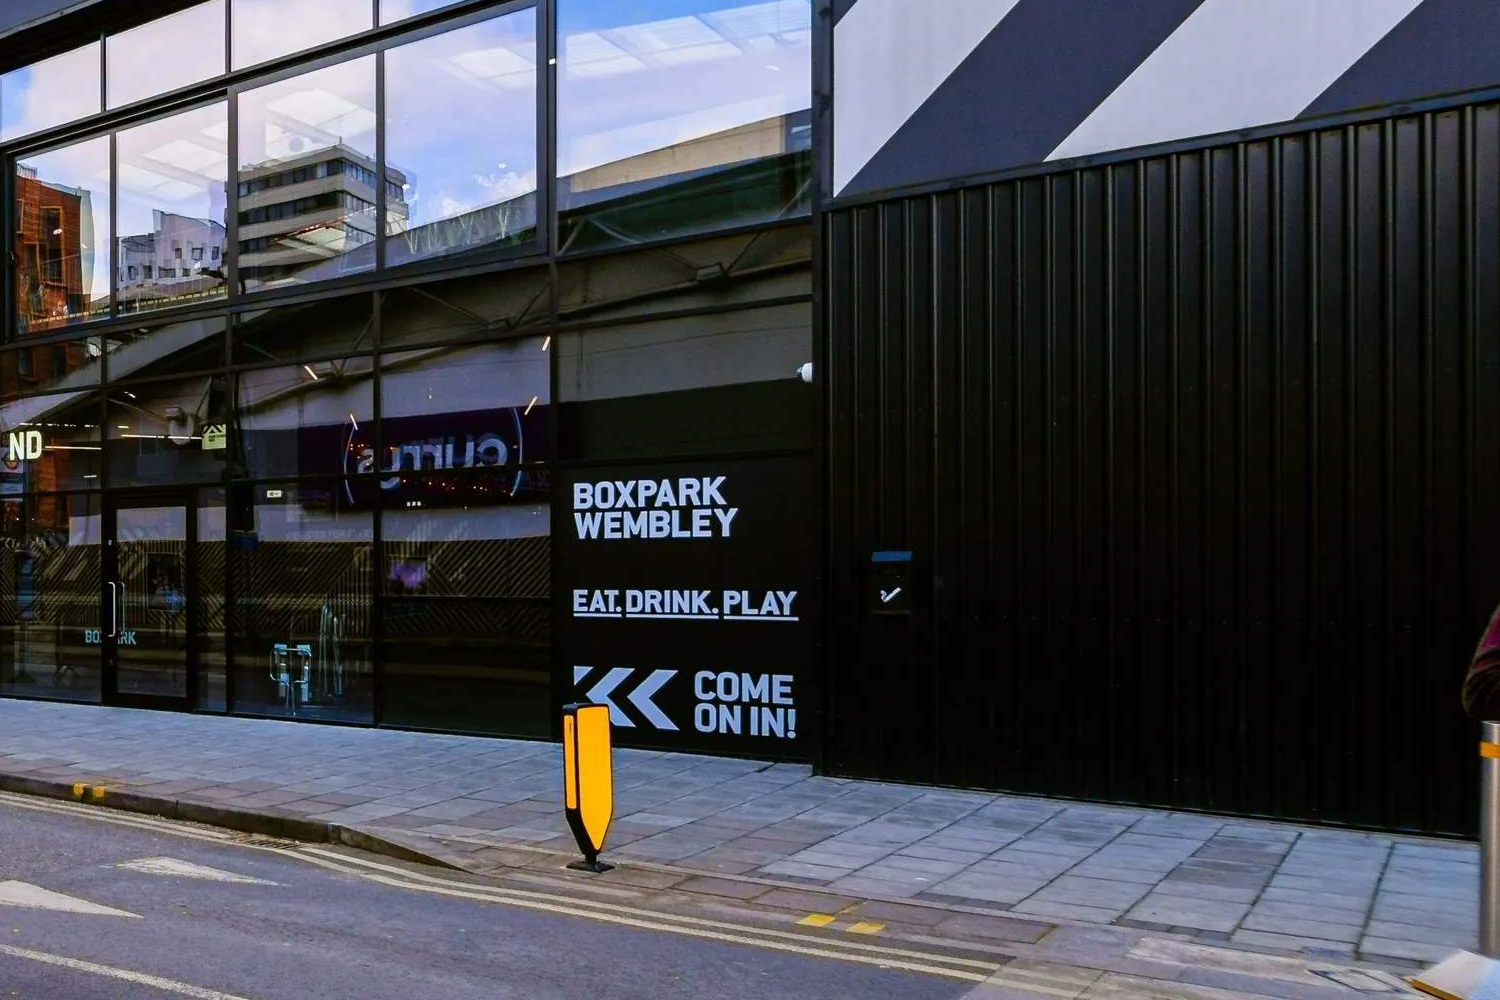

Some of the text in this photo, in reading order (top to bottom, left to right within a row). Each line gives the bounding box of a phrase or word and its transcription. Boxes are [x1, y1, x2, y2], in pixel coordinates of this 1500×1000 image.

[9, 430, 42, 460] ND
[573, 476, 727, 509] BOXPARK
[574, 507, 738, 539] WEMBLEY
[573, 589, 622, 613] EAT.
[626, 590, 719, 615] DRINK.
[694, 670, 794, 705] COME
[694, 702, 796, 739] ON IN!
